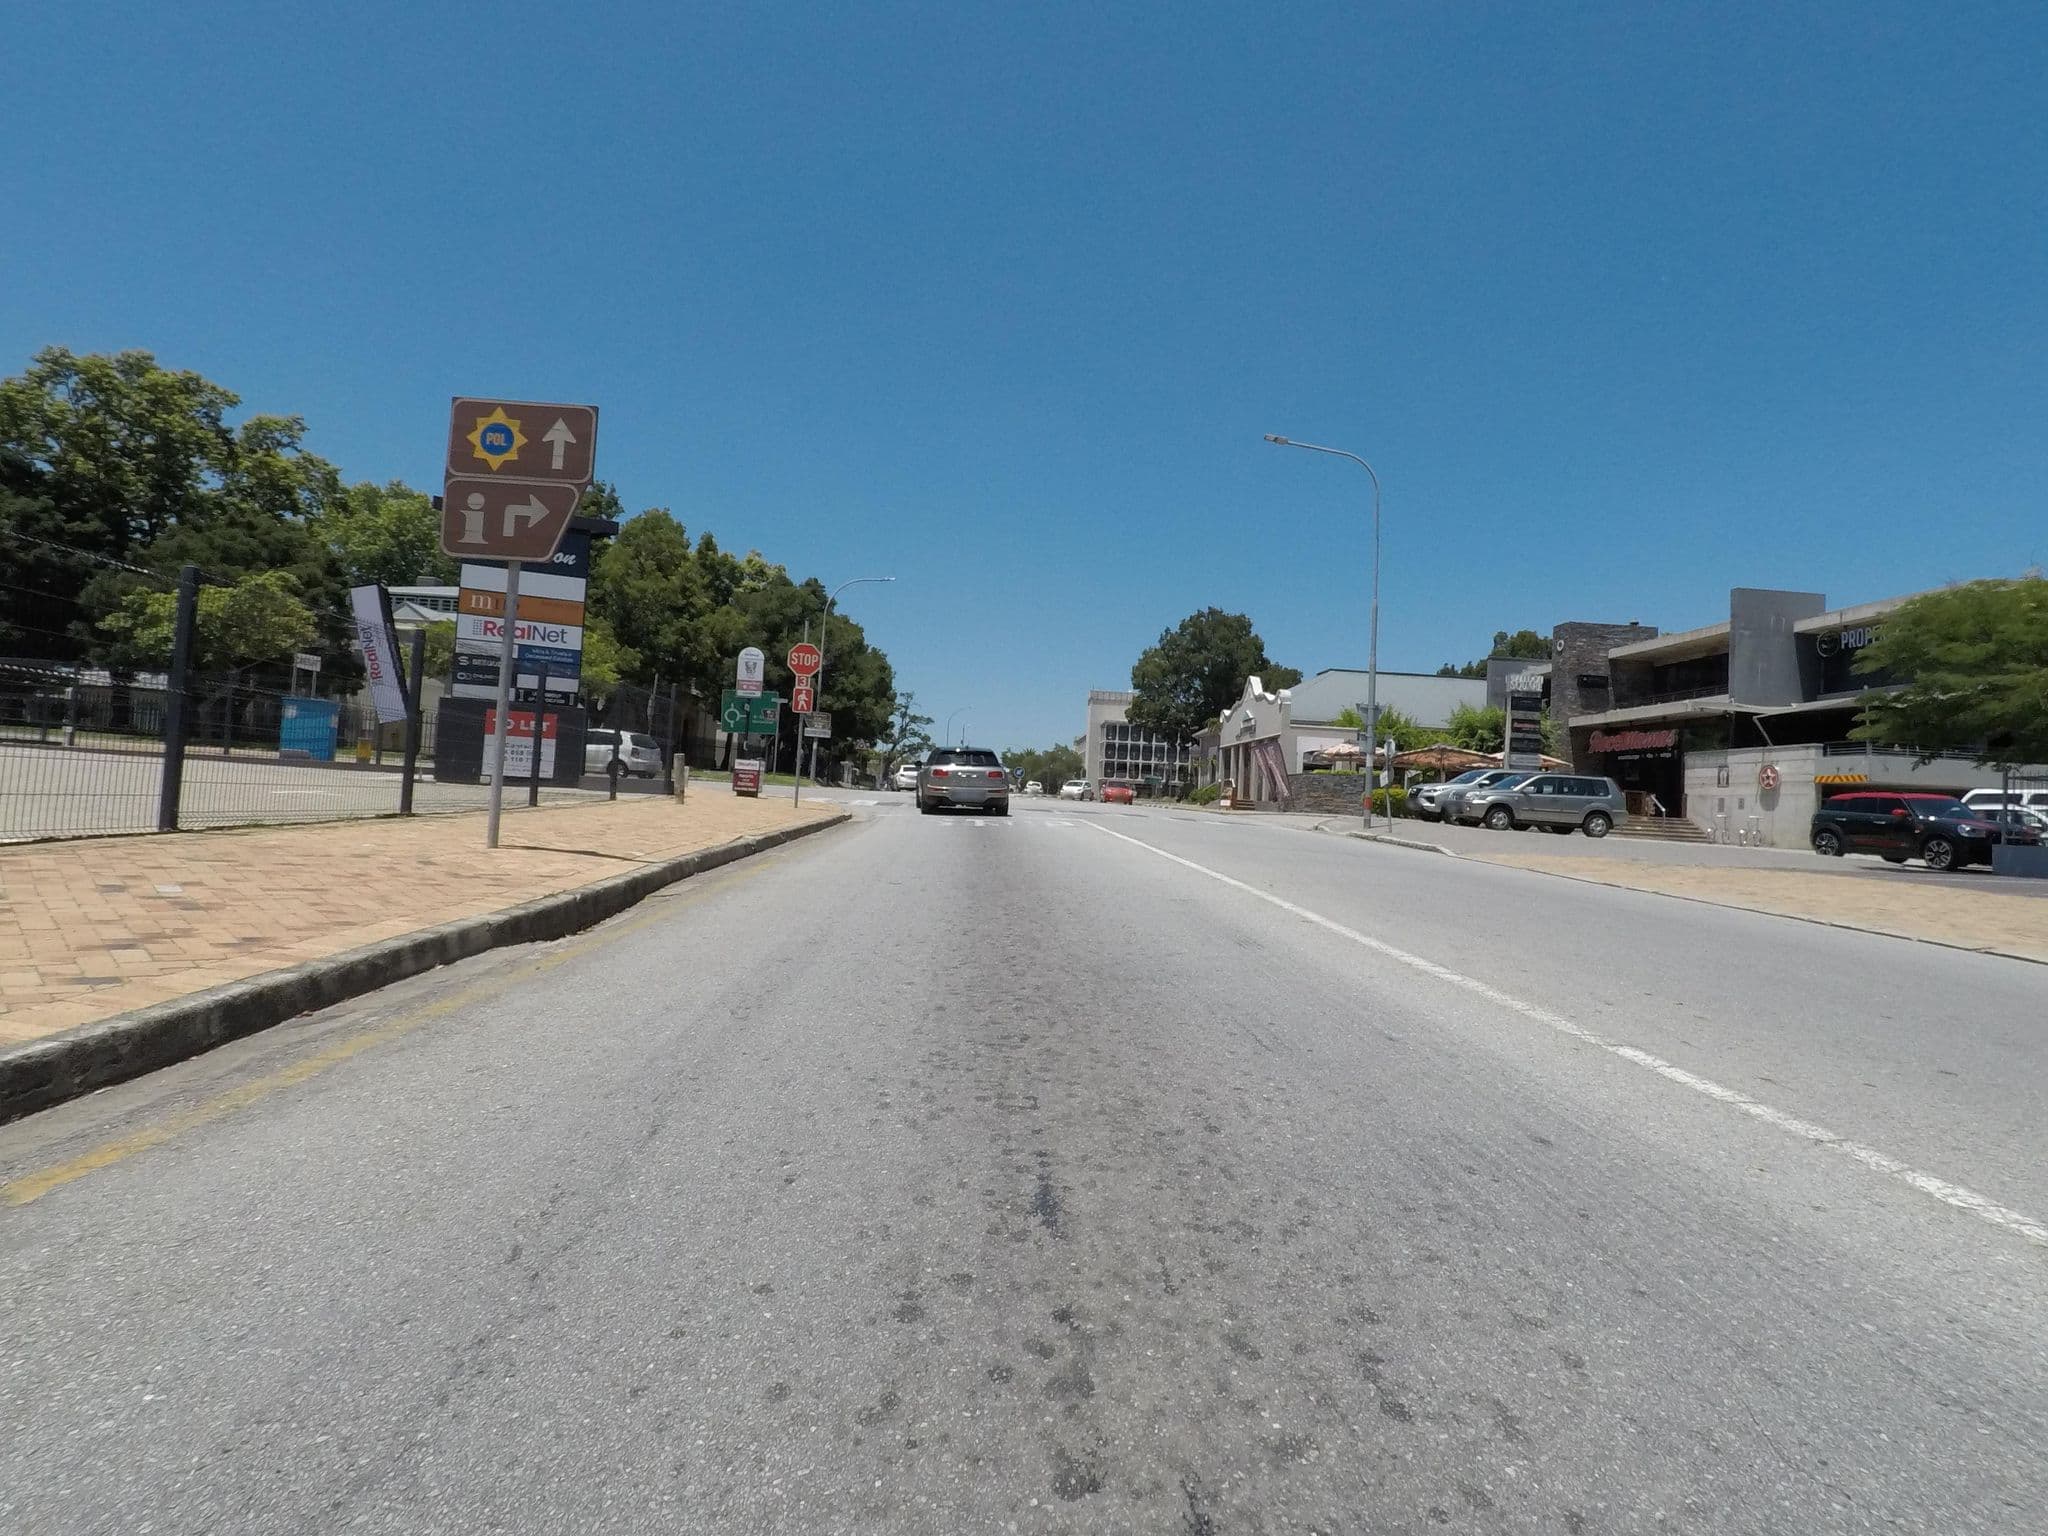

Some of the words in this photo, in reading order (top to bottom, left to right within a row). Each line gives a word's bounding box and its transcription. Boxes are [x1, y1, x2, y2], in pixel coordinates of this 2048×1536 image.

[486, 432, 507, 446] POL
[483, 620, 568, 645] RealNet
[791, 653, 819, 667] STOP
[799, 676, 807, 686] 3
